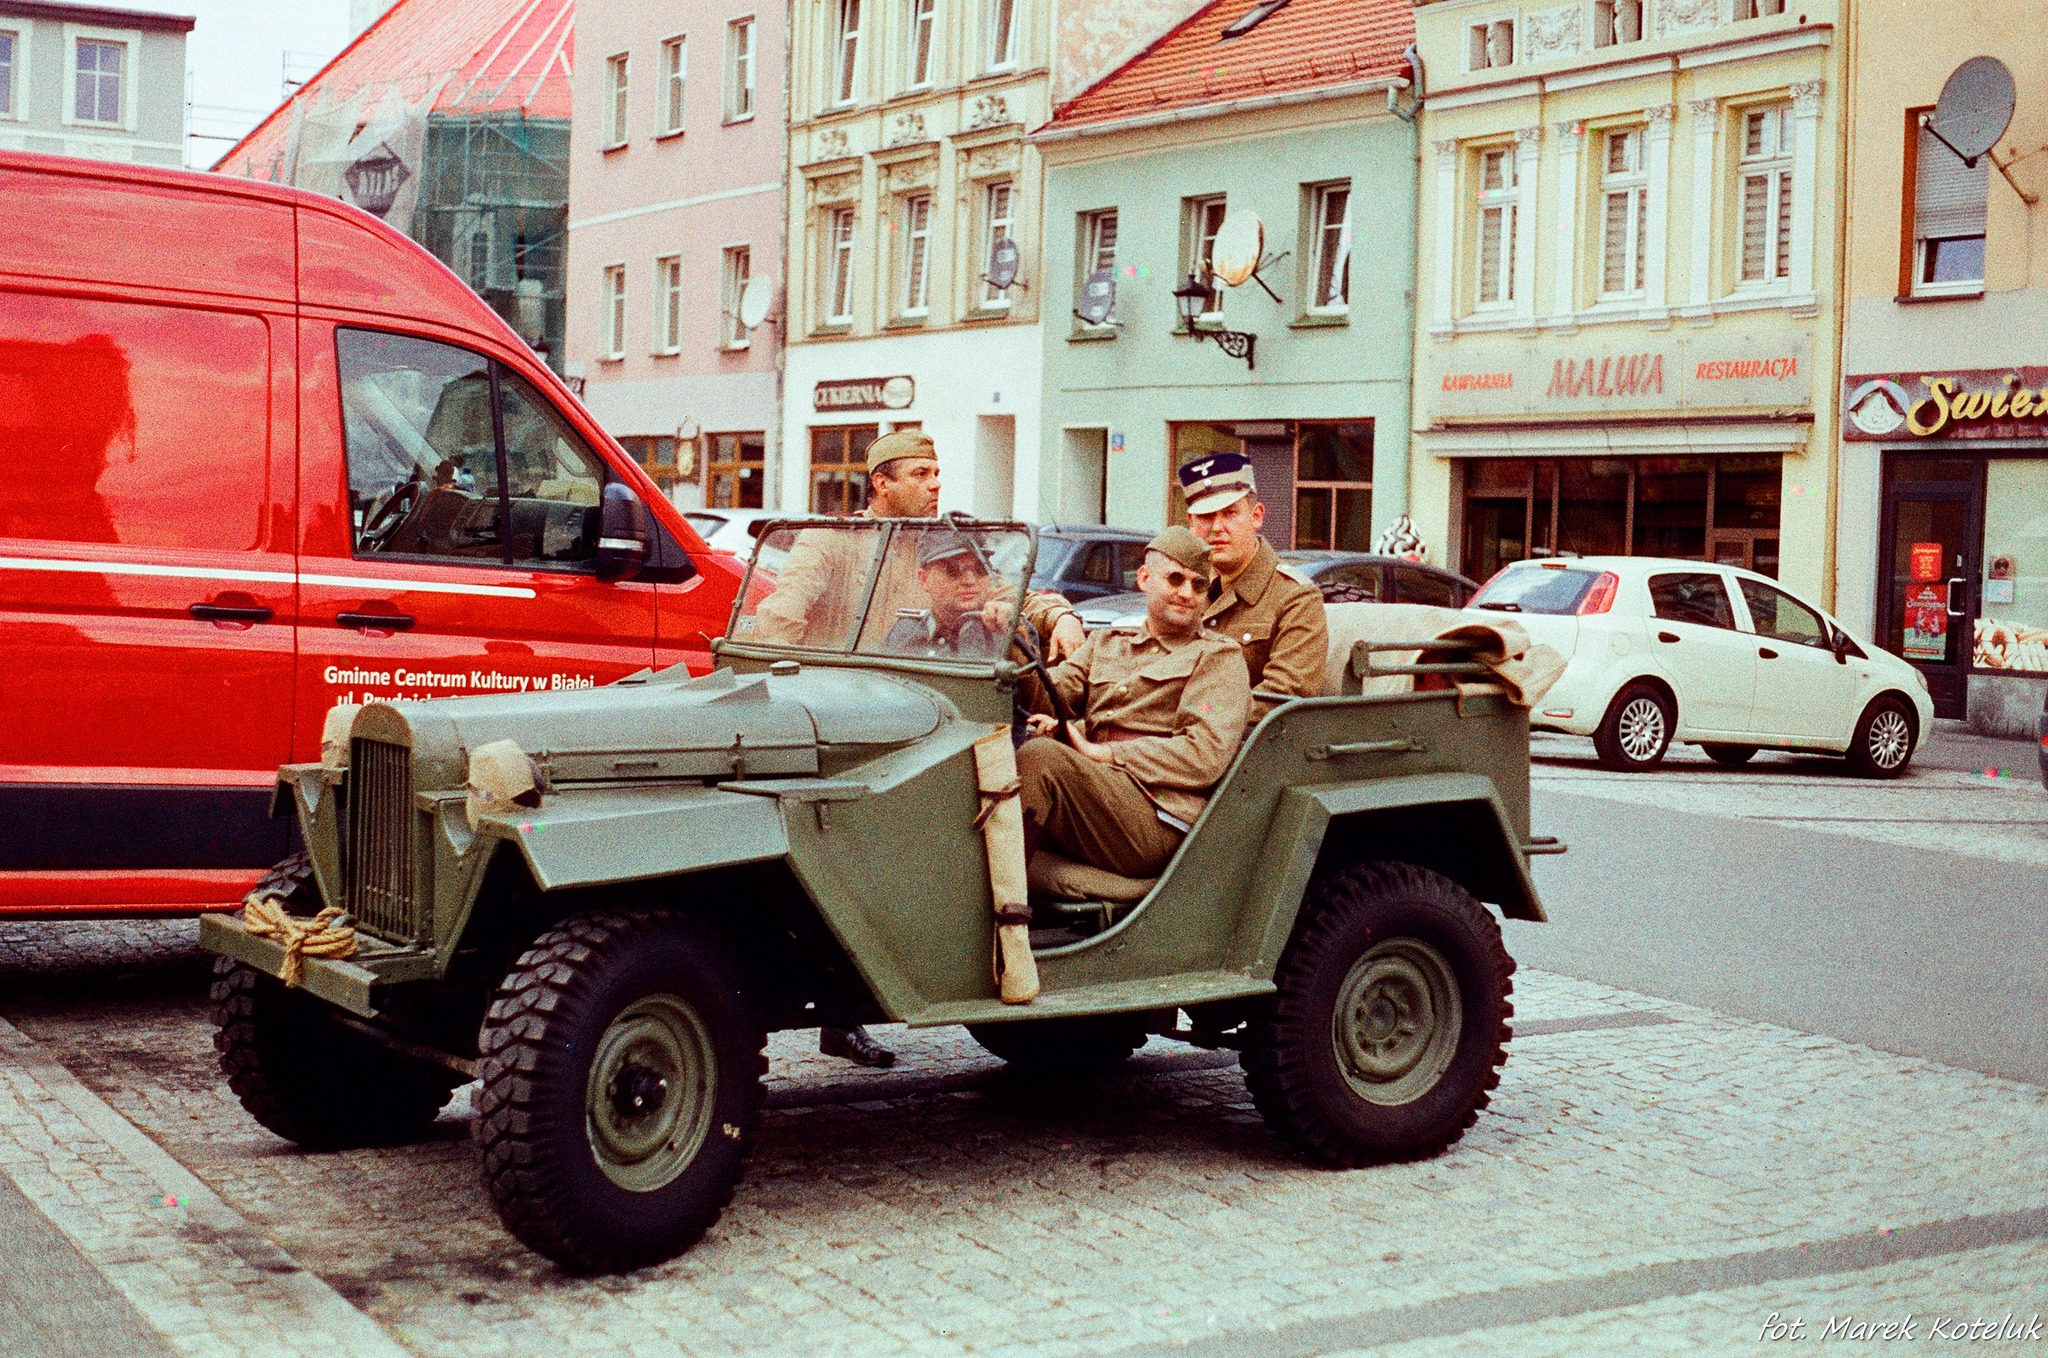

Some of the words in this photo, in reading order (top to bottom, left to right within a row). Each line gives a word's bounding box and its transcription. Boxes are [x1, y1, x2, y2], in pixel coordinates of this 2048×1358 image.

[1545, 353, 1663, 398] MALWA
[1696, 358, 1796, 382] RESTAURACJA
[324, 666, 391, 685] Gminne
[394, 668, 467, 688] Centrum
[470, 671, 529, 693] Kultury
[532, 676, 547, 690] w
[551, 674, 595, 691] Białej
